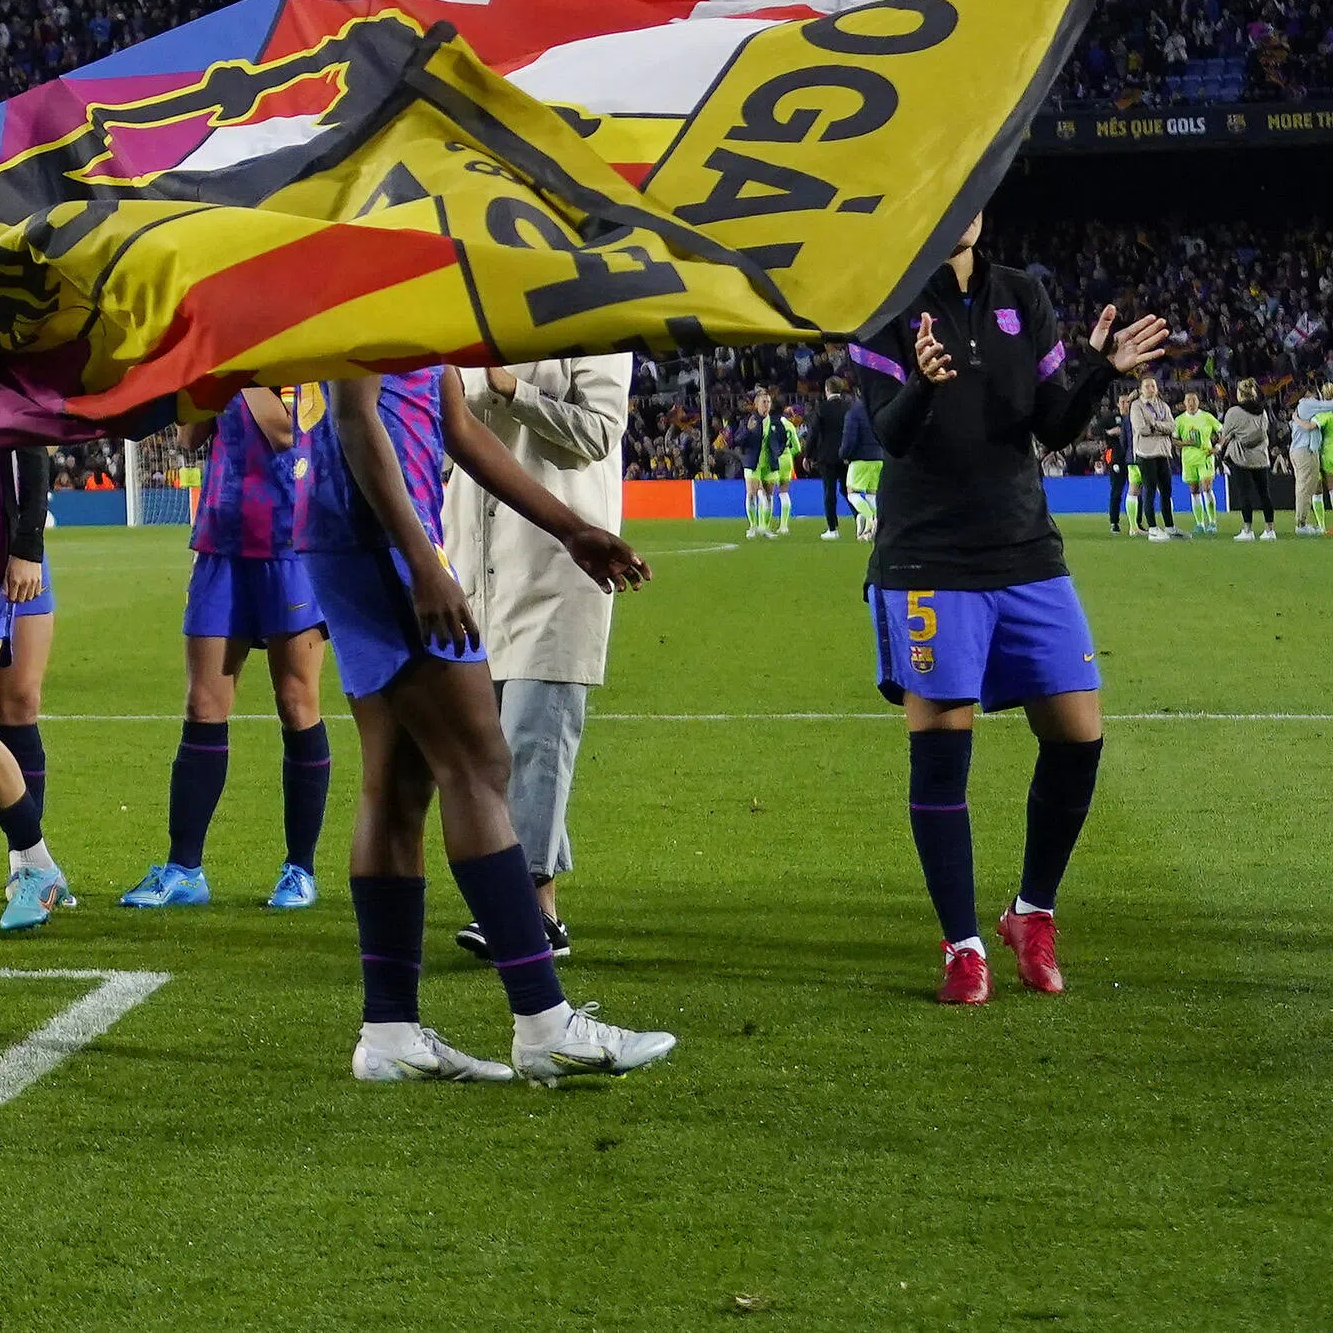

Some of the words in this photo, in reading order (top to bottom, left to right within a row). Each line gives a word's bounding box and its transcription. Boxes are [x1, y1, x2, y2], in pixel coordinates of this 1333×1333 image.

[1096, 116, 1127, 137] MÉS
[1130, 119, 1163, 140] QUE
[1166, 117, 1206, 136] GOLS
[1268, 113, 1313, 130] MORE
[906, 590, 937, 642] 5
